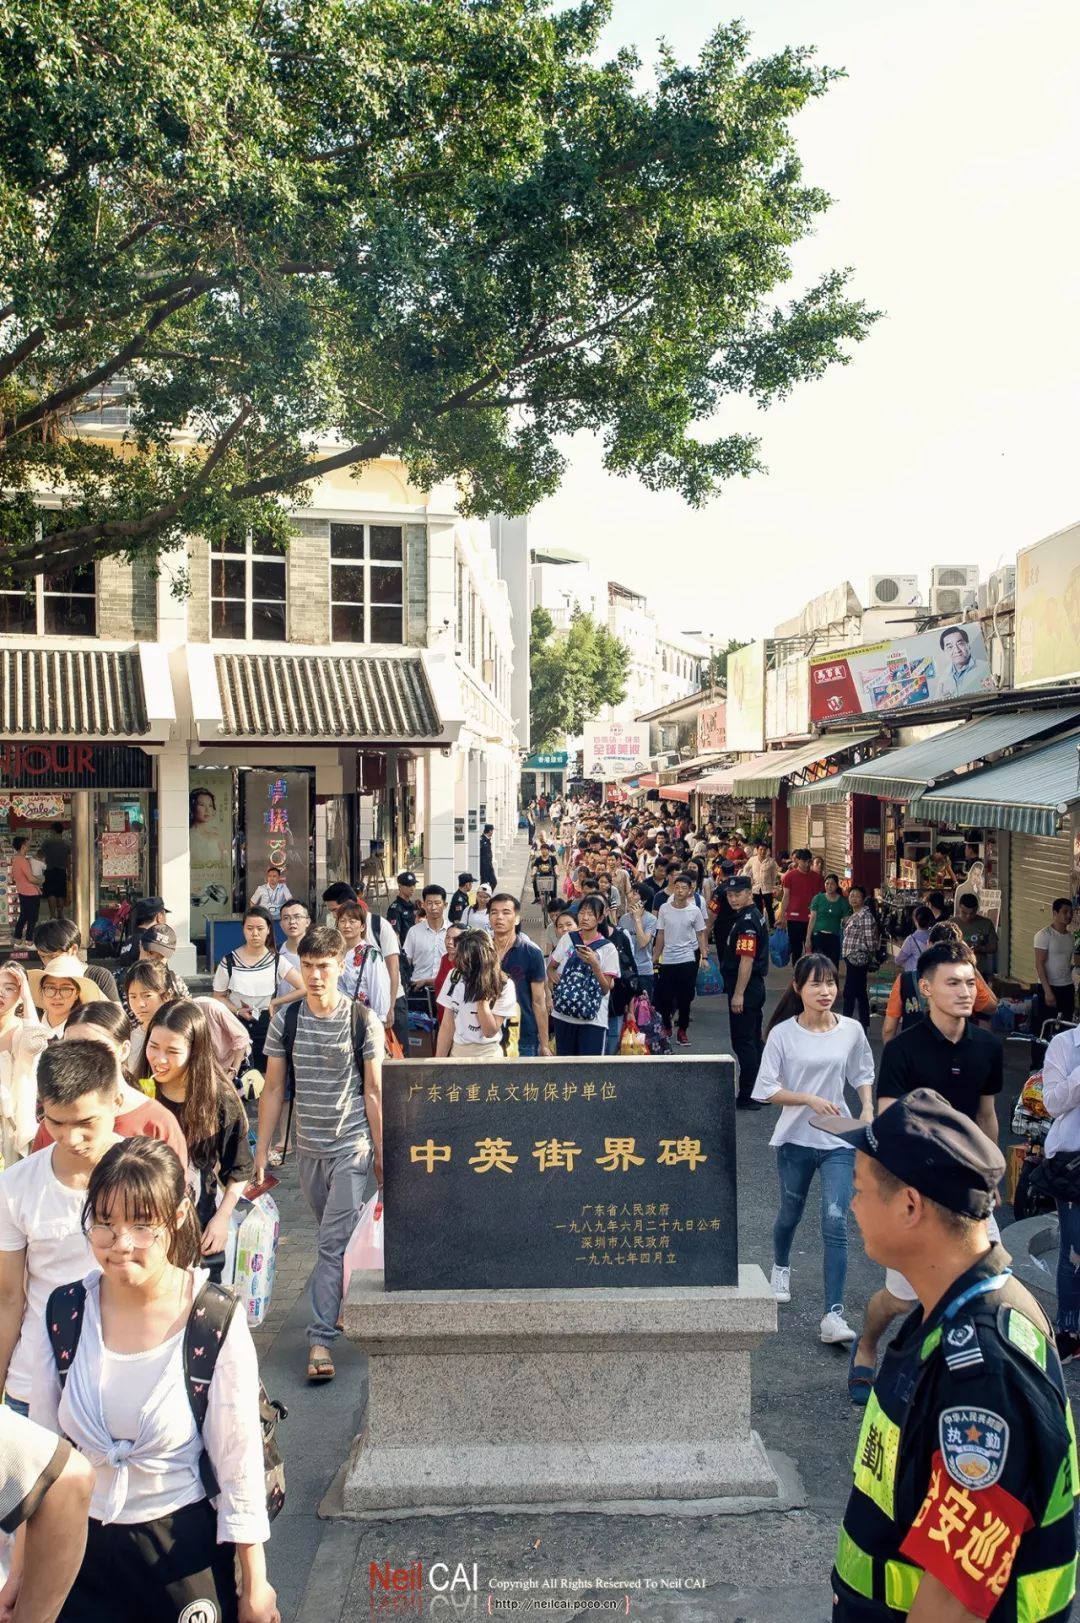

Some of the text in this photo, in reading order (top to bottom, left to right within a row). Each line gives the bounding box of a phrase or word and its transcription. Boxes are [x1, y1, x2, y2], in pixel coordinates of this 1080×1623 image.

[408, 1082, 617, 1102] 广东省重点文物保护单位
[409, 1136, 708, 1174] 中英街界碑
[581, 1203, 670, 1216] 广东省人民政府
[555, 1218, 721, 1233] 一九八九年六月二十九日公布
[580, 1235, 670, 1249] 深圳市人民政府
[575, 1252, 677, 1265] 一九九七年四月立
[947, 1426, 962, 1444] 执
